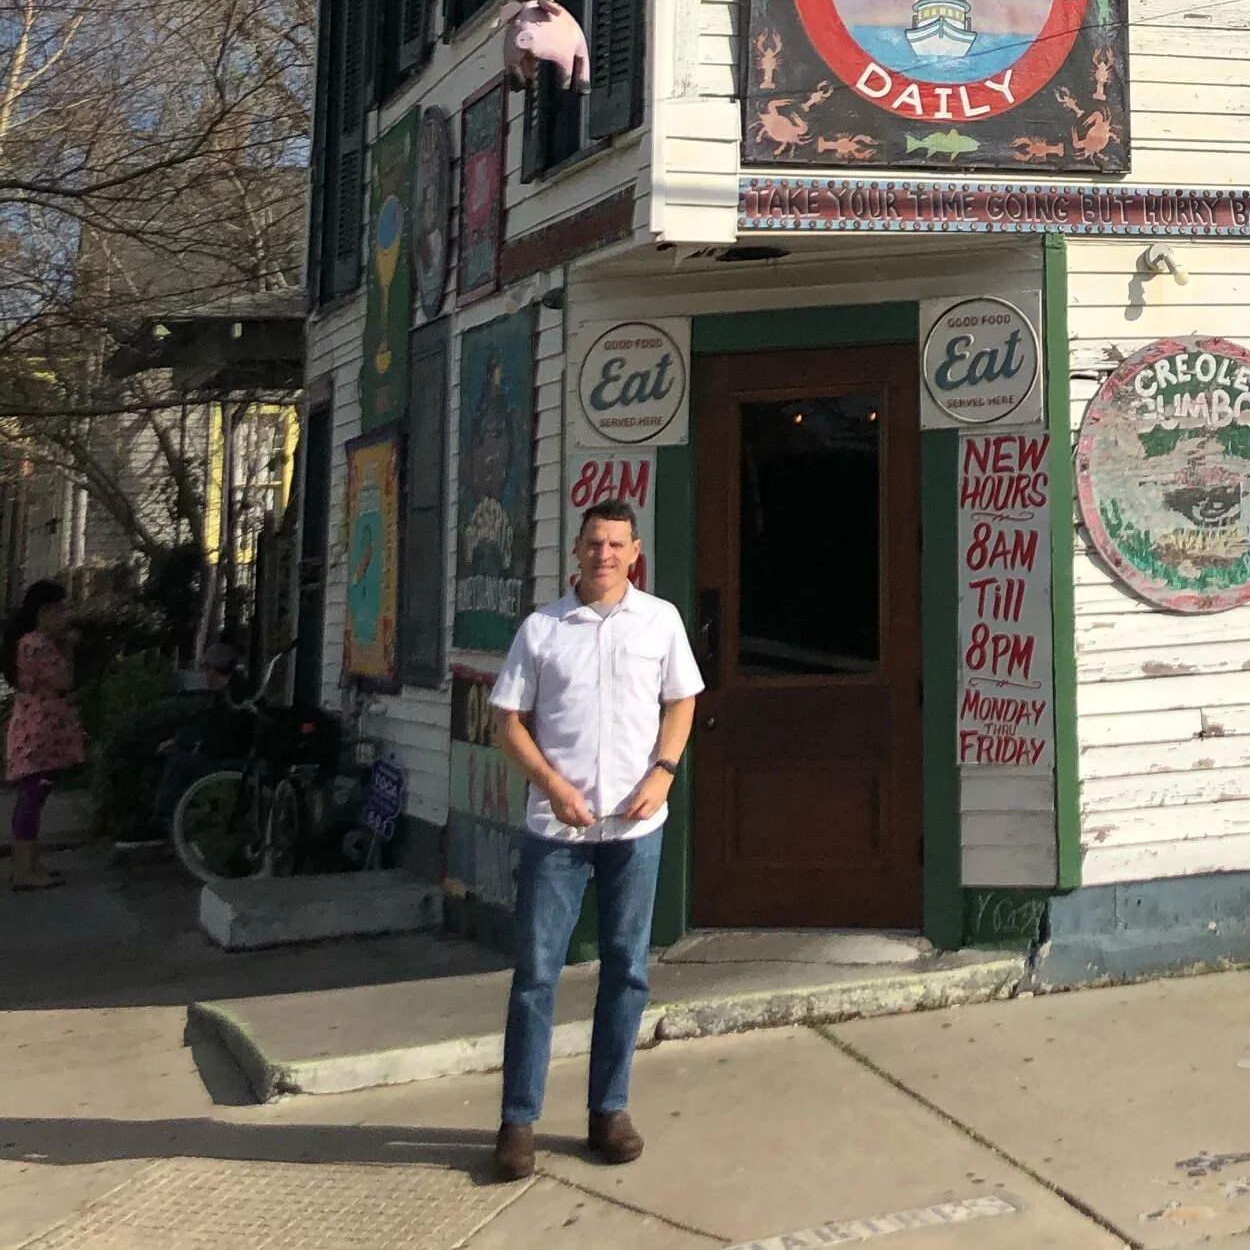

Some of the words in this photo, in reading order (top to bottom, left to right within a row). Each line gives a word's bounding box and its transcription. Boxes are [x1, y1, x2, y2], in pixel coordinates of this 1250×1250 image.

[855, 61, 1016, 120] DAILY
[747, 188, 821, 219] TAKE
[827, 189, 904, 221] YOUR
[908, 191, 979, 222] TIME
[986, 193, 1070, 223] GOING
[1081, 194, 1134, 225] BUT
[1143, 197, 1220, 227] HURRY
[947, 316, 978, 329] GOOD
[980, 314, 1011, 325] FOOD
[604, 340, 632, 349] GOOD
[634, 338, 663, 349] FOOD
[935, 328, 1025, 391] Eat
[590, 352, 674, 411] Eat
[947, 397, 985, 409] SERVED
[987, 395, 1015, 406] HERE
[600, 418, 637, 428] SERVED
[638, 416, 663, 427] HERE
[963, 433, 1050, 475] NEW
[571, 460, 651, 507] 8AM
[960, 472, 1048, 511] HOURS
[966, 522, 1039, 572] 8AM
[965, 622, 1036, 680] 8PM
[960, 689, 1046, 727] MONDAY
[959, 729, 1046, 766] FRIDAY
[985, 722, 1017, 736] THRU
